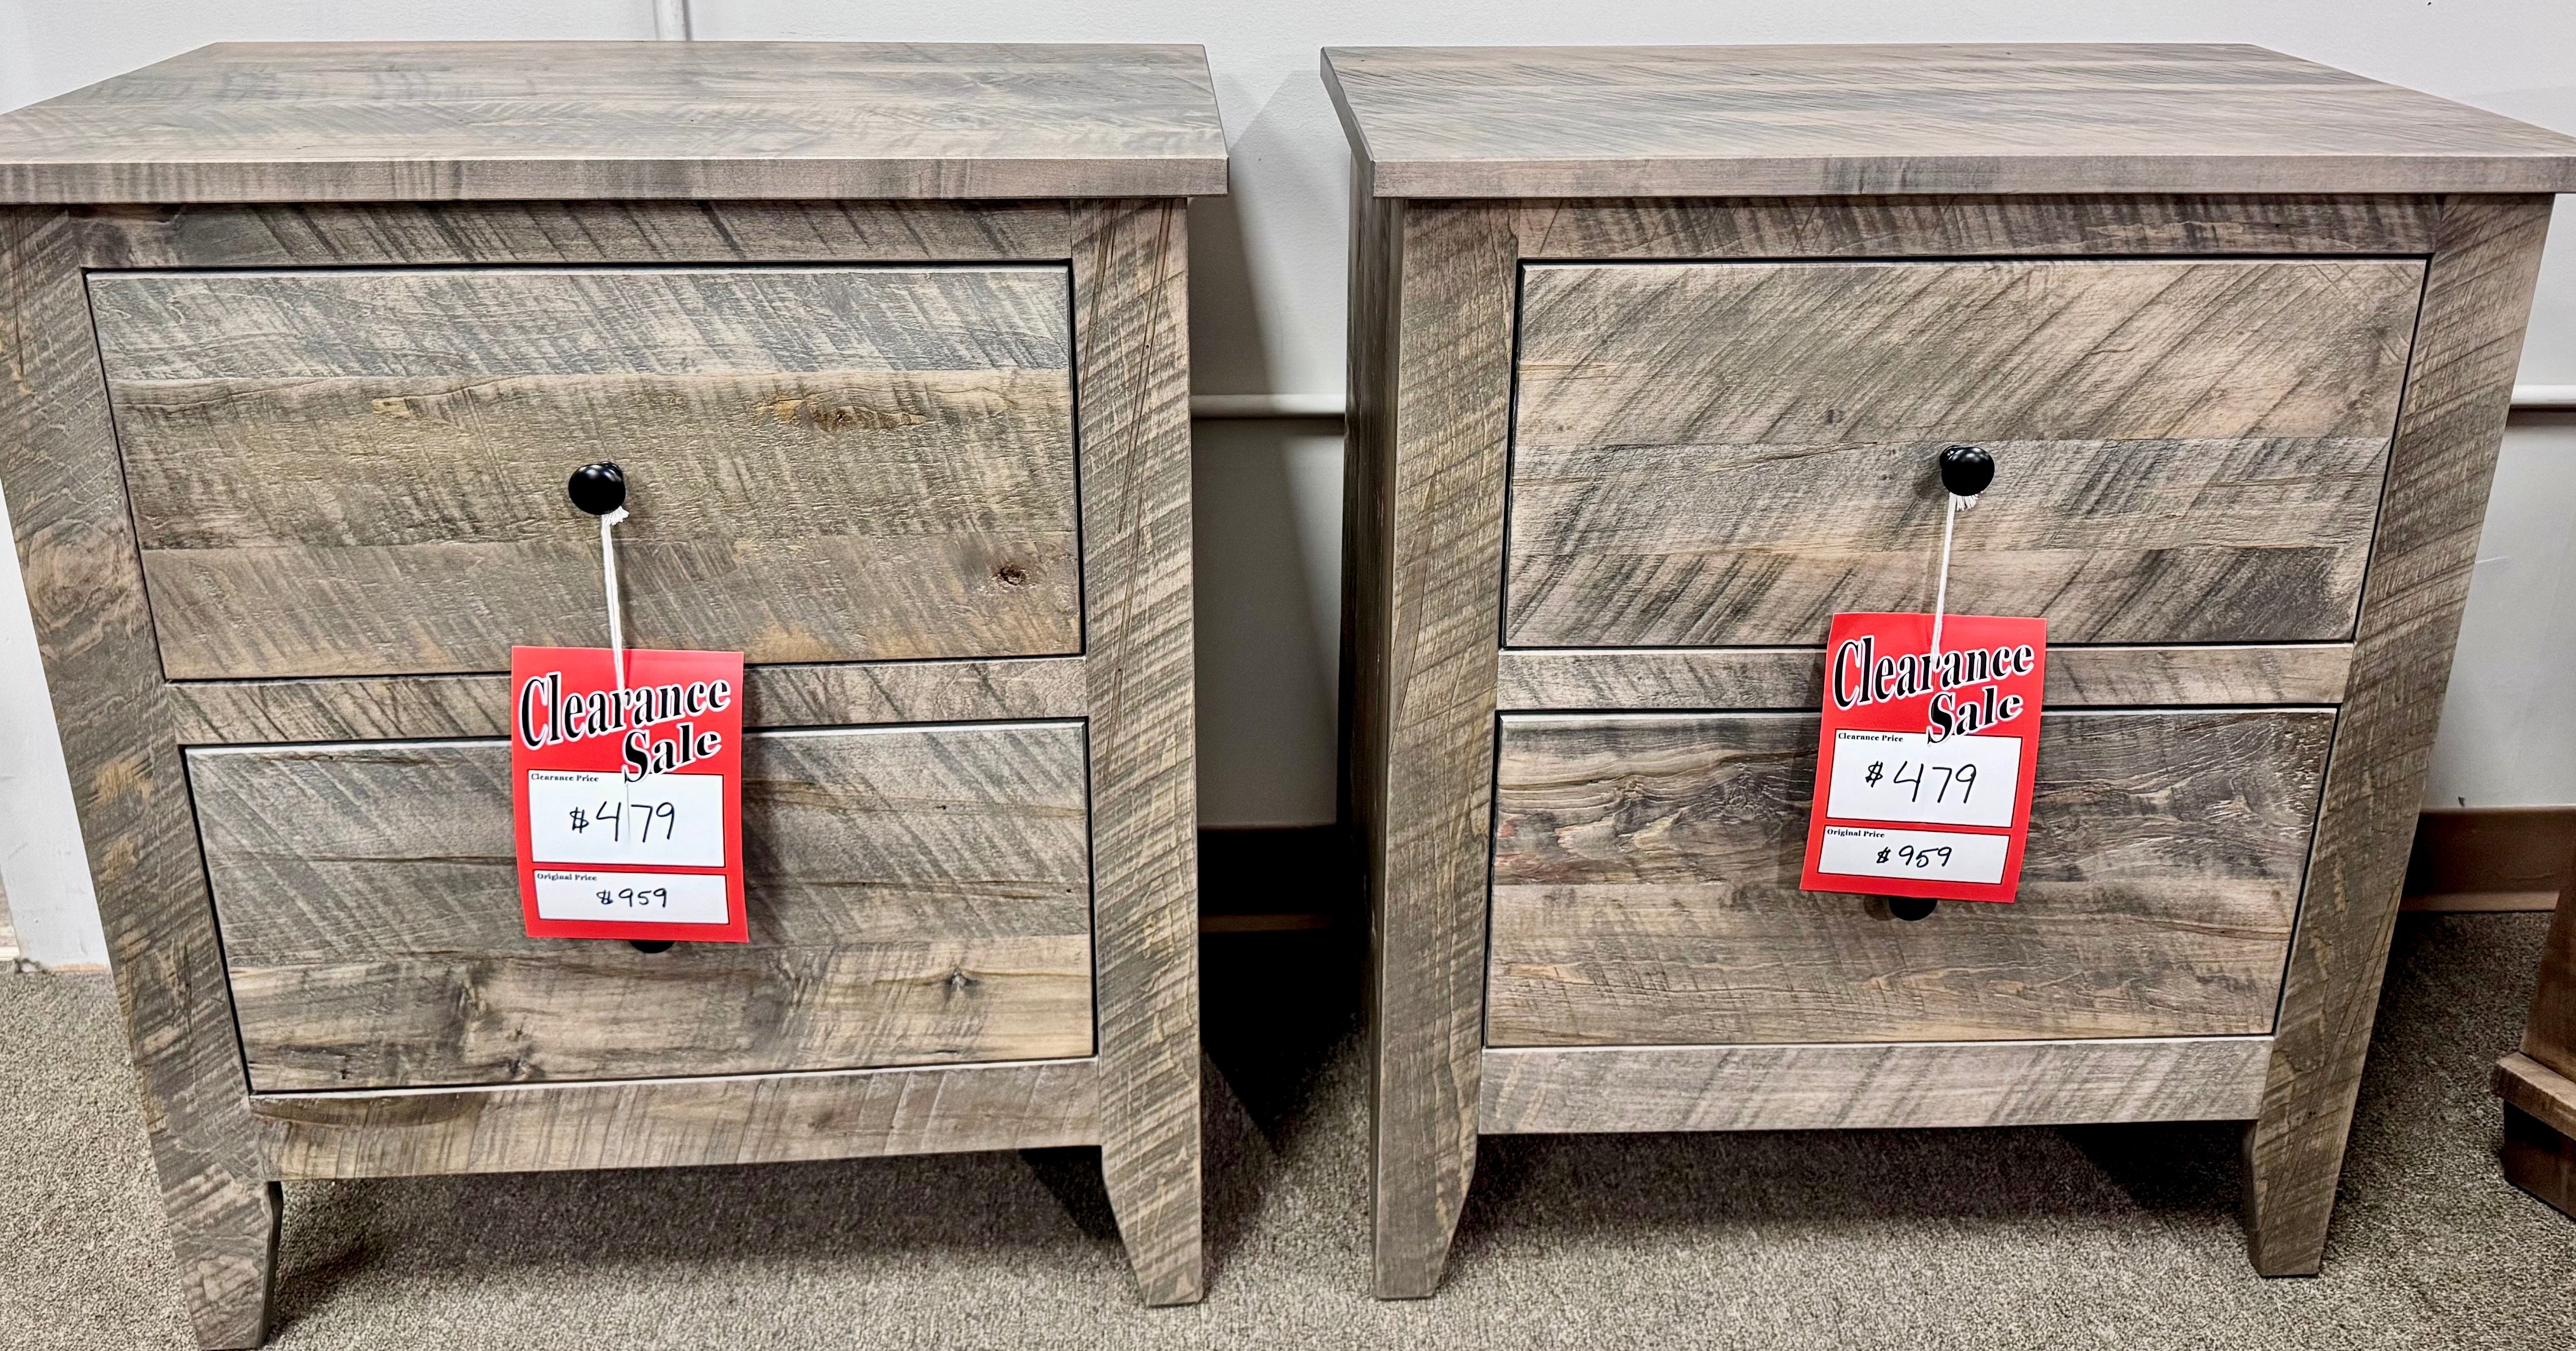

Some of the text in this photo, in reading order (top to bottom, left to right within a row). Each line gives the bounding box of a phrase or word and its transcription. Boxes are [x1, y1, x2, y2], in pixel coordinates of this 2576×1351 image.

[1832, 635, 2035, 710] Clearance
[519, 671, 730, 750] Clearance
[1926, 686, 2023, 747] Sale
[622, 722, 721, 784] Sale
[1838, 732, 1903, 743] Clearance Price
[531, 773, 599, 783] Clearance Price
[1865, 761, 1977, 804] $479
[570, 801, 675, 843] $479
[1827, 828, 1885, 838] Original Price
[1876, 845, 1952, 868] $959
[537, 872, 573, 882] Original
[596, 888, 667, 908] $959
